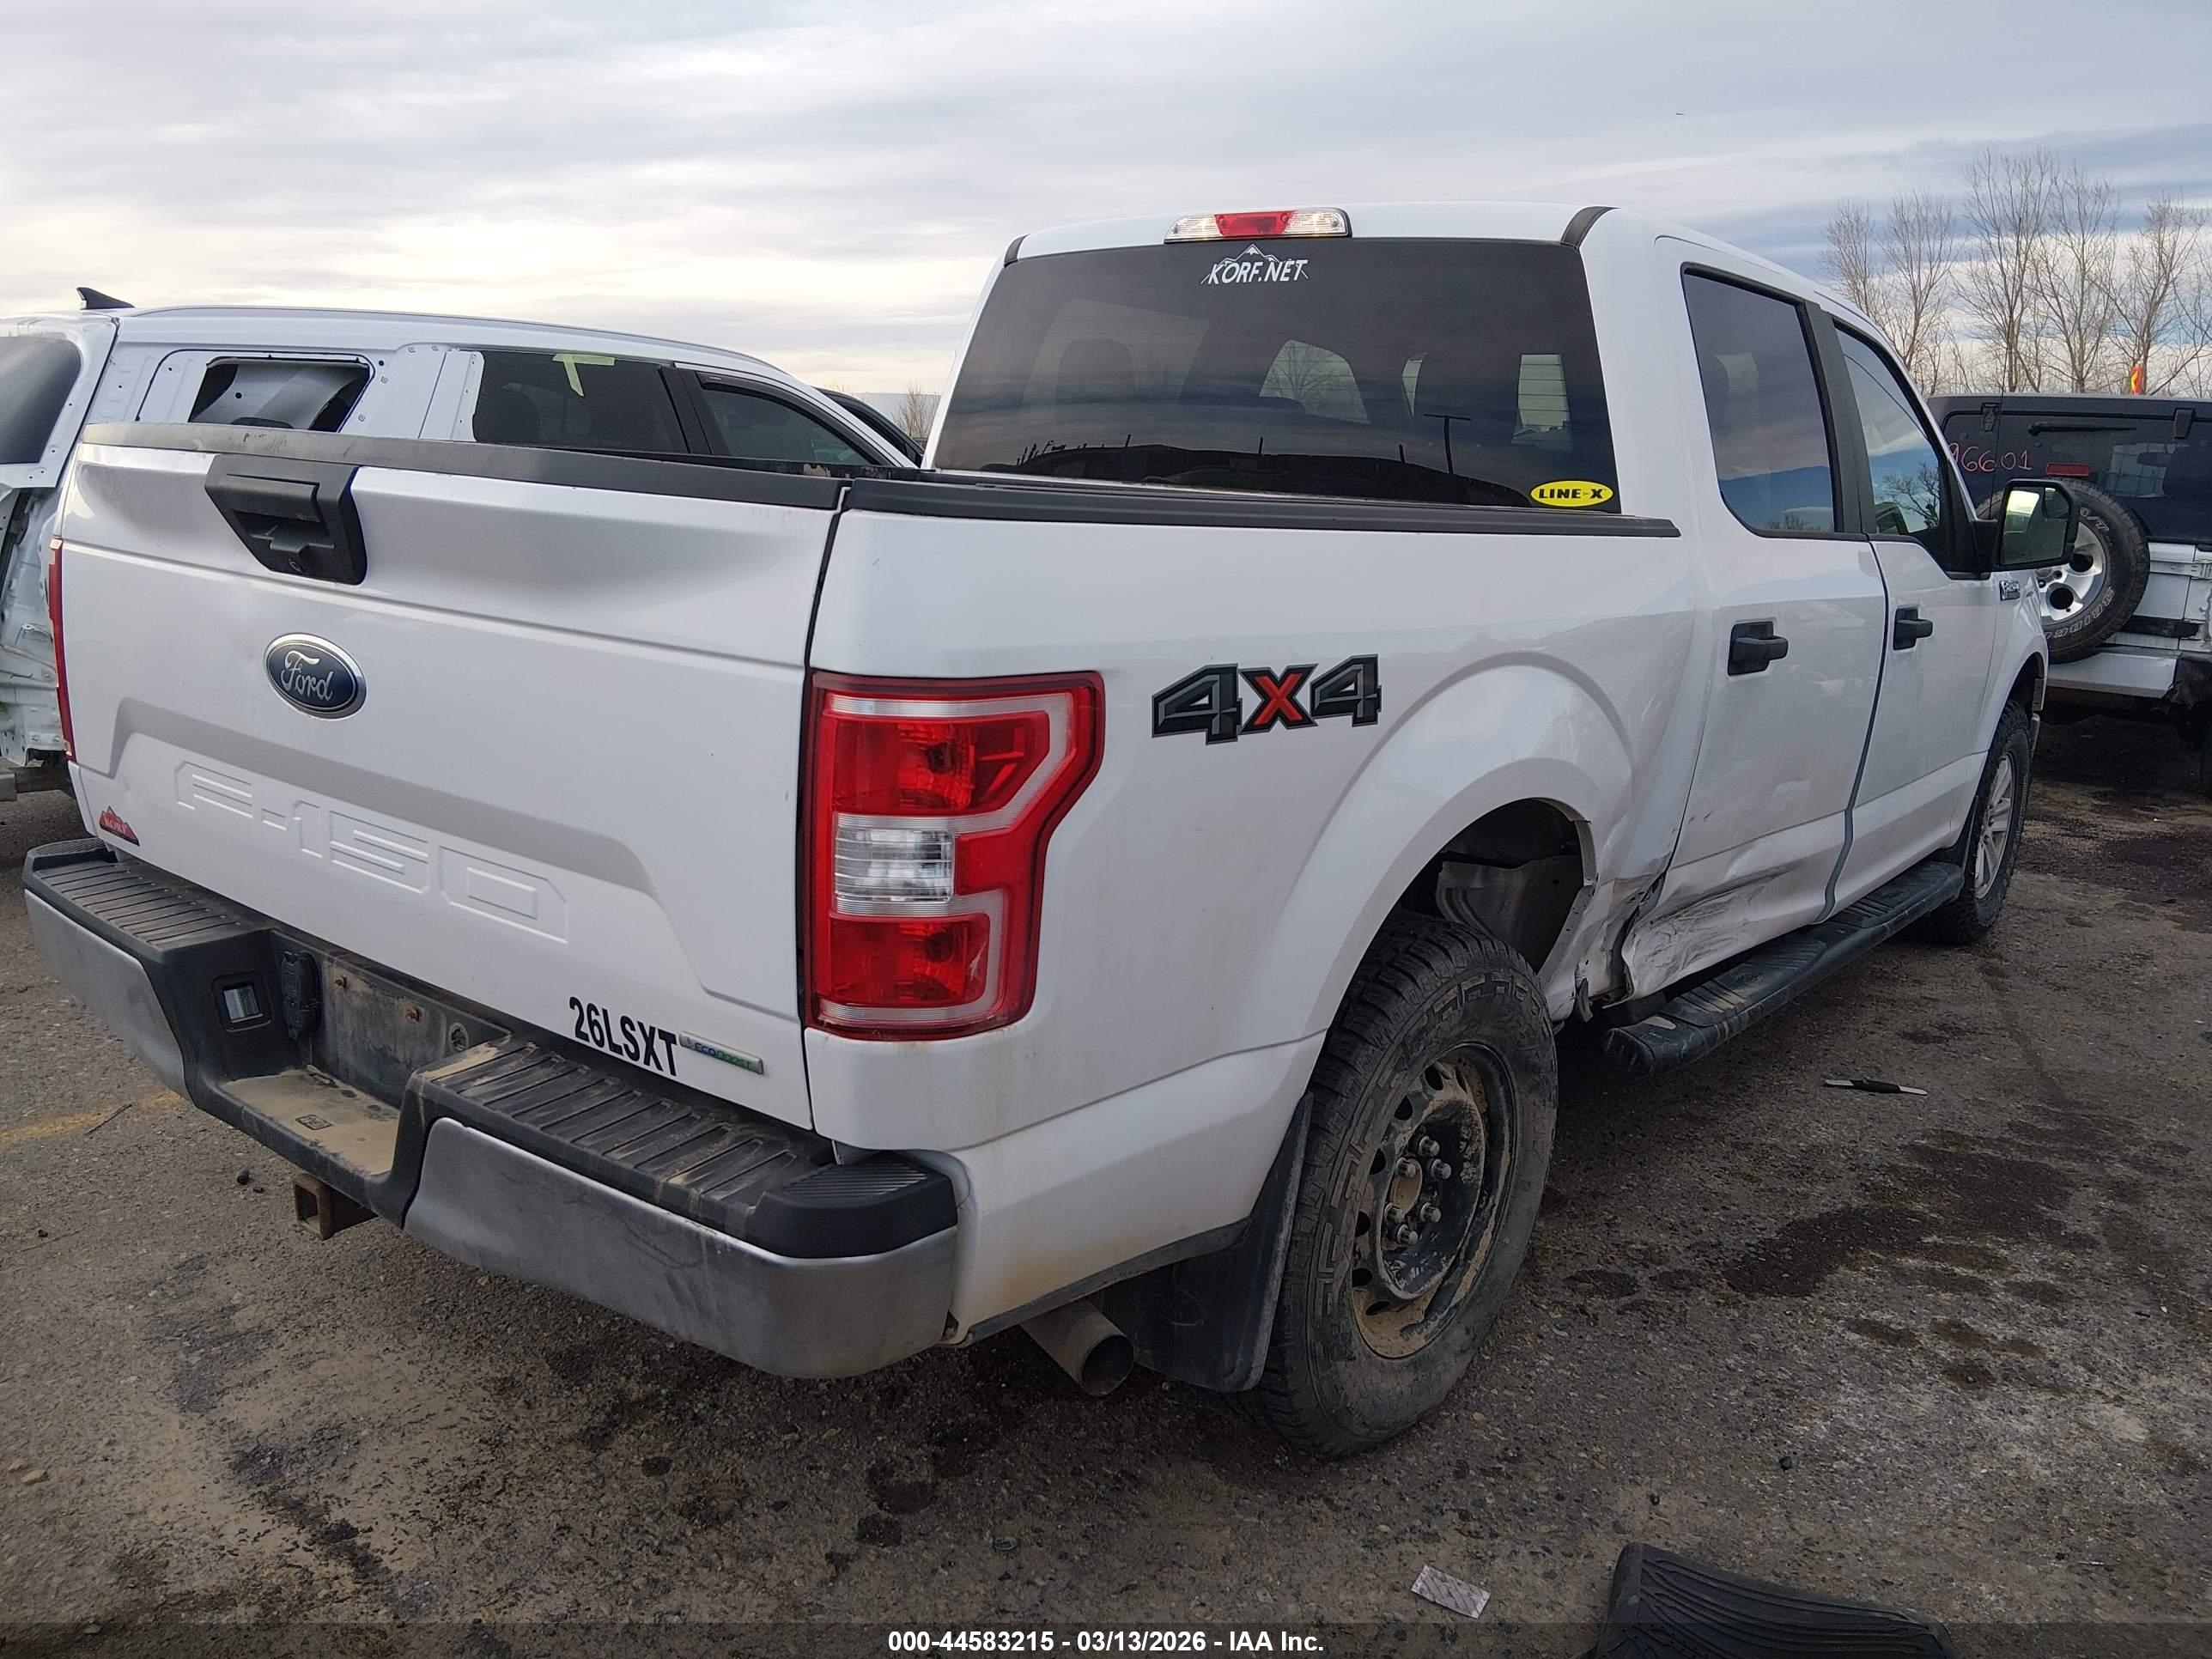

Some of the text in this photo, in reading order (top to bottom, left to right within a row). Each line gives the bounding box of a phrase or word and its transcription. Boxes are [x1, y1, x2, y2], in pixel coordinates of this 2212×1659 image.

[1207, 259, 1309, 285] KORF.NET
[1539, 488, 1604, 499] LINE-X
[280, 650, 335, 702] Ford
[174, 761, 568, 945] F-150
[569, 996, 678, 1077] 26LSXT
